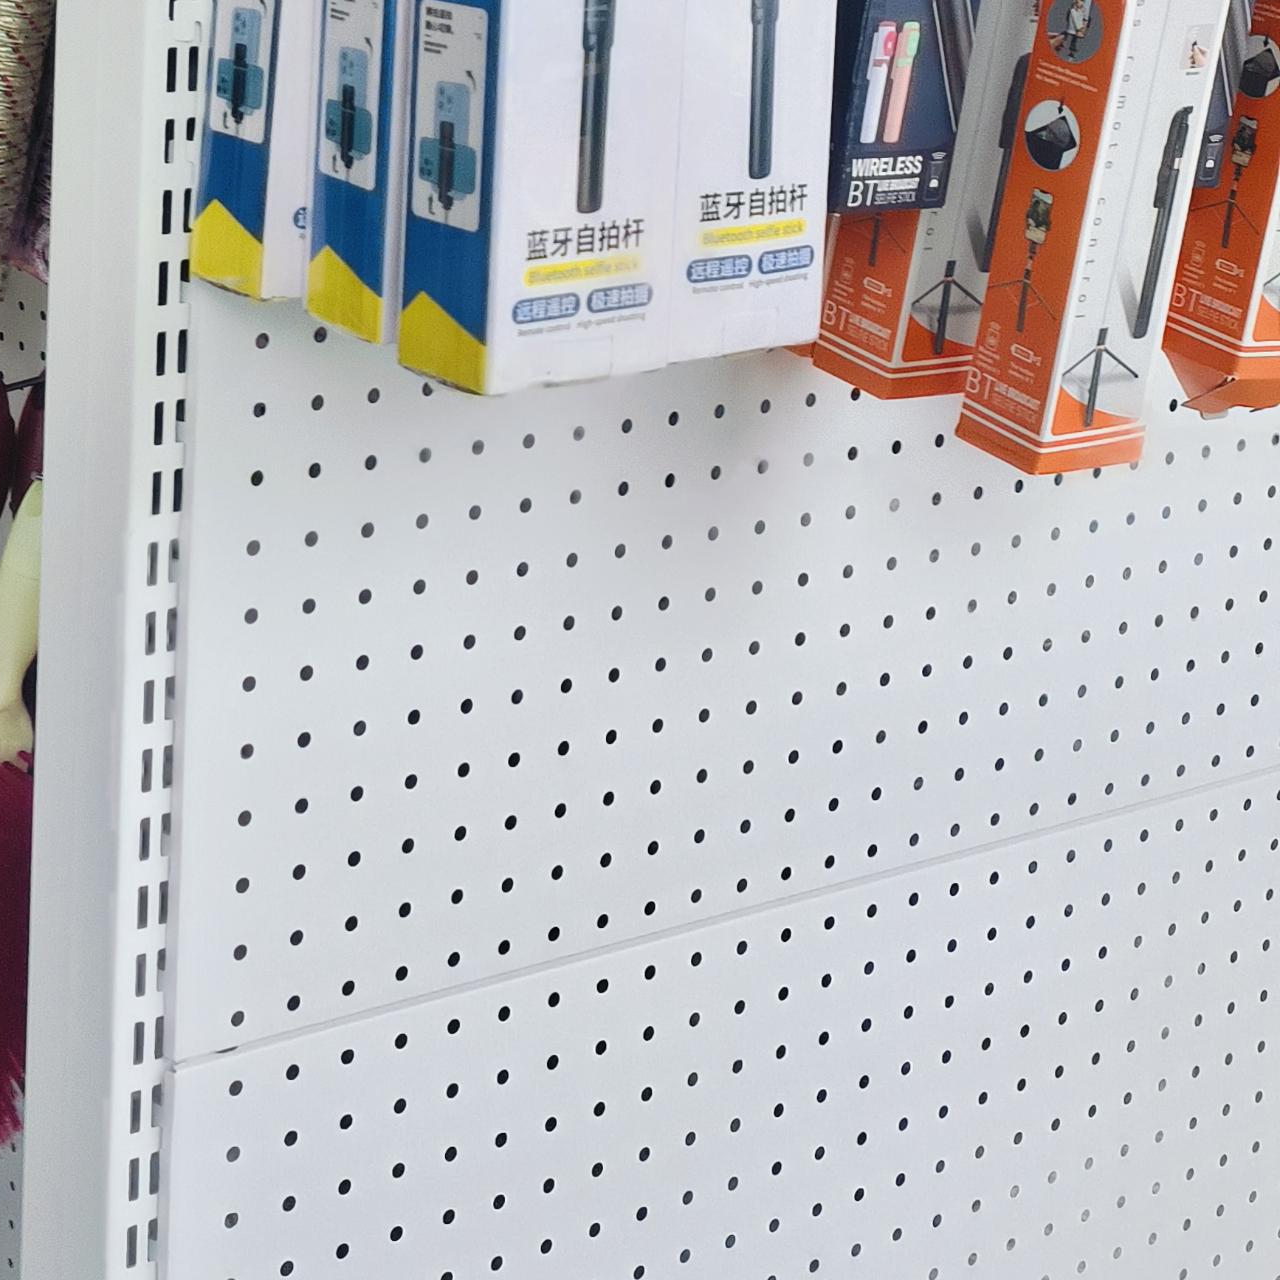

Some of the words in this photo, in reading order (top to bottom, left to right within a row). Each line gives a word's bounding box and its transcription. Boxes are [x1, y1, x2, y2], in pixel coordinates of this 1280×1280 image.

[851, 155, 924, 177] WIRELESS
[699, 183, 808, 223] 蓝牙自拍杆
[846, 180, 879, 207] BT
[525, 217, 646, 262] 蓝牙自拍杆
[1074, 196, 1107, 319] control
[1171, 282, 1202, 312] BT
[822, 299, 852, 331] BT
[965, 365, 998, 400] BT
